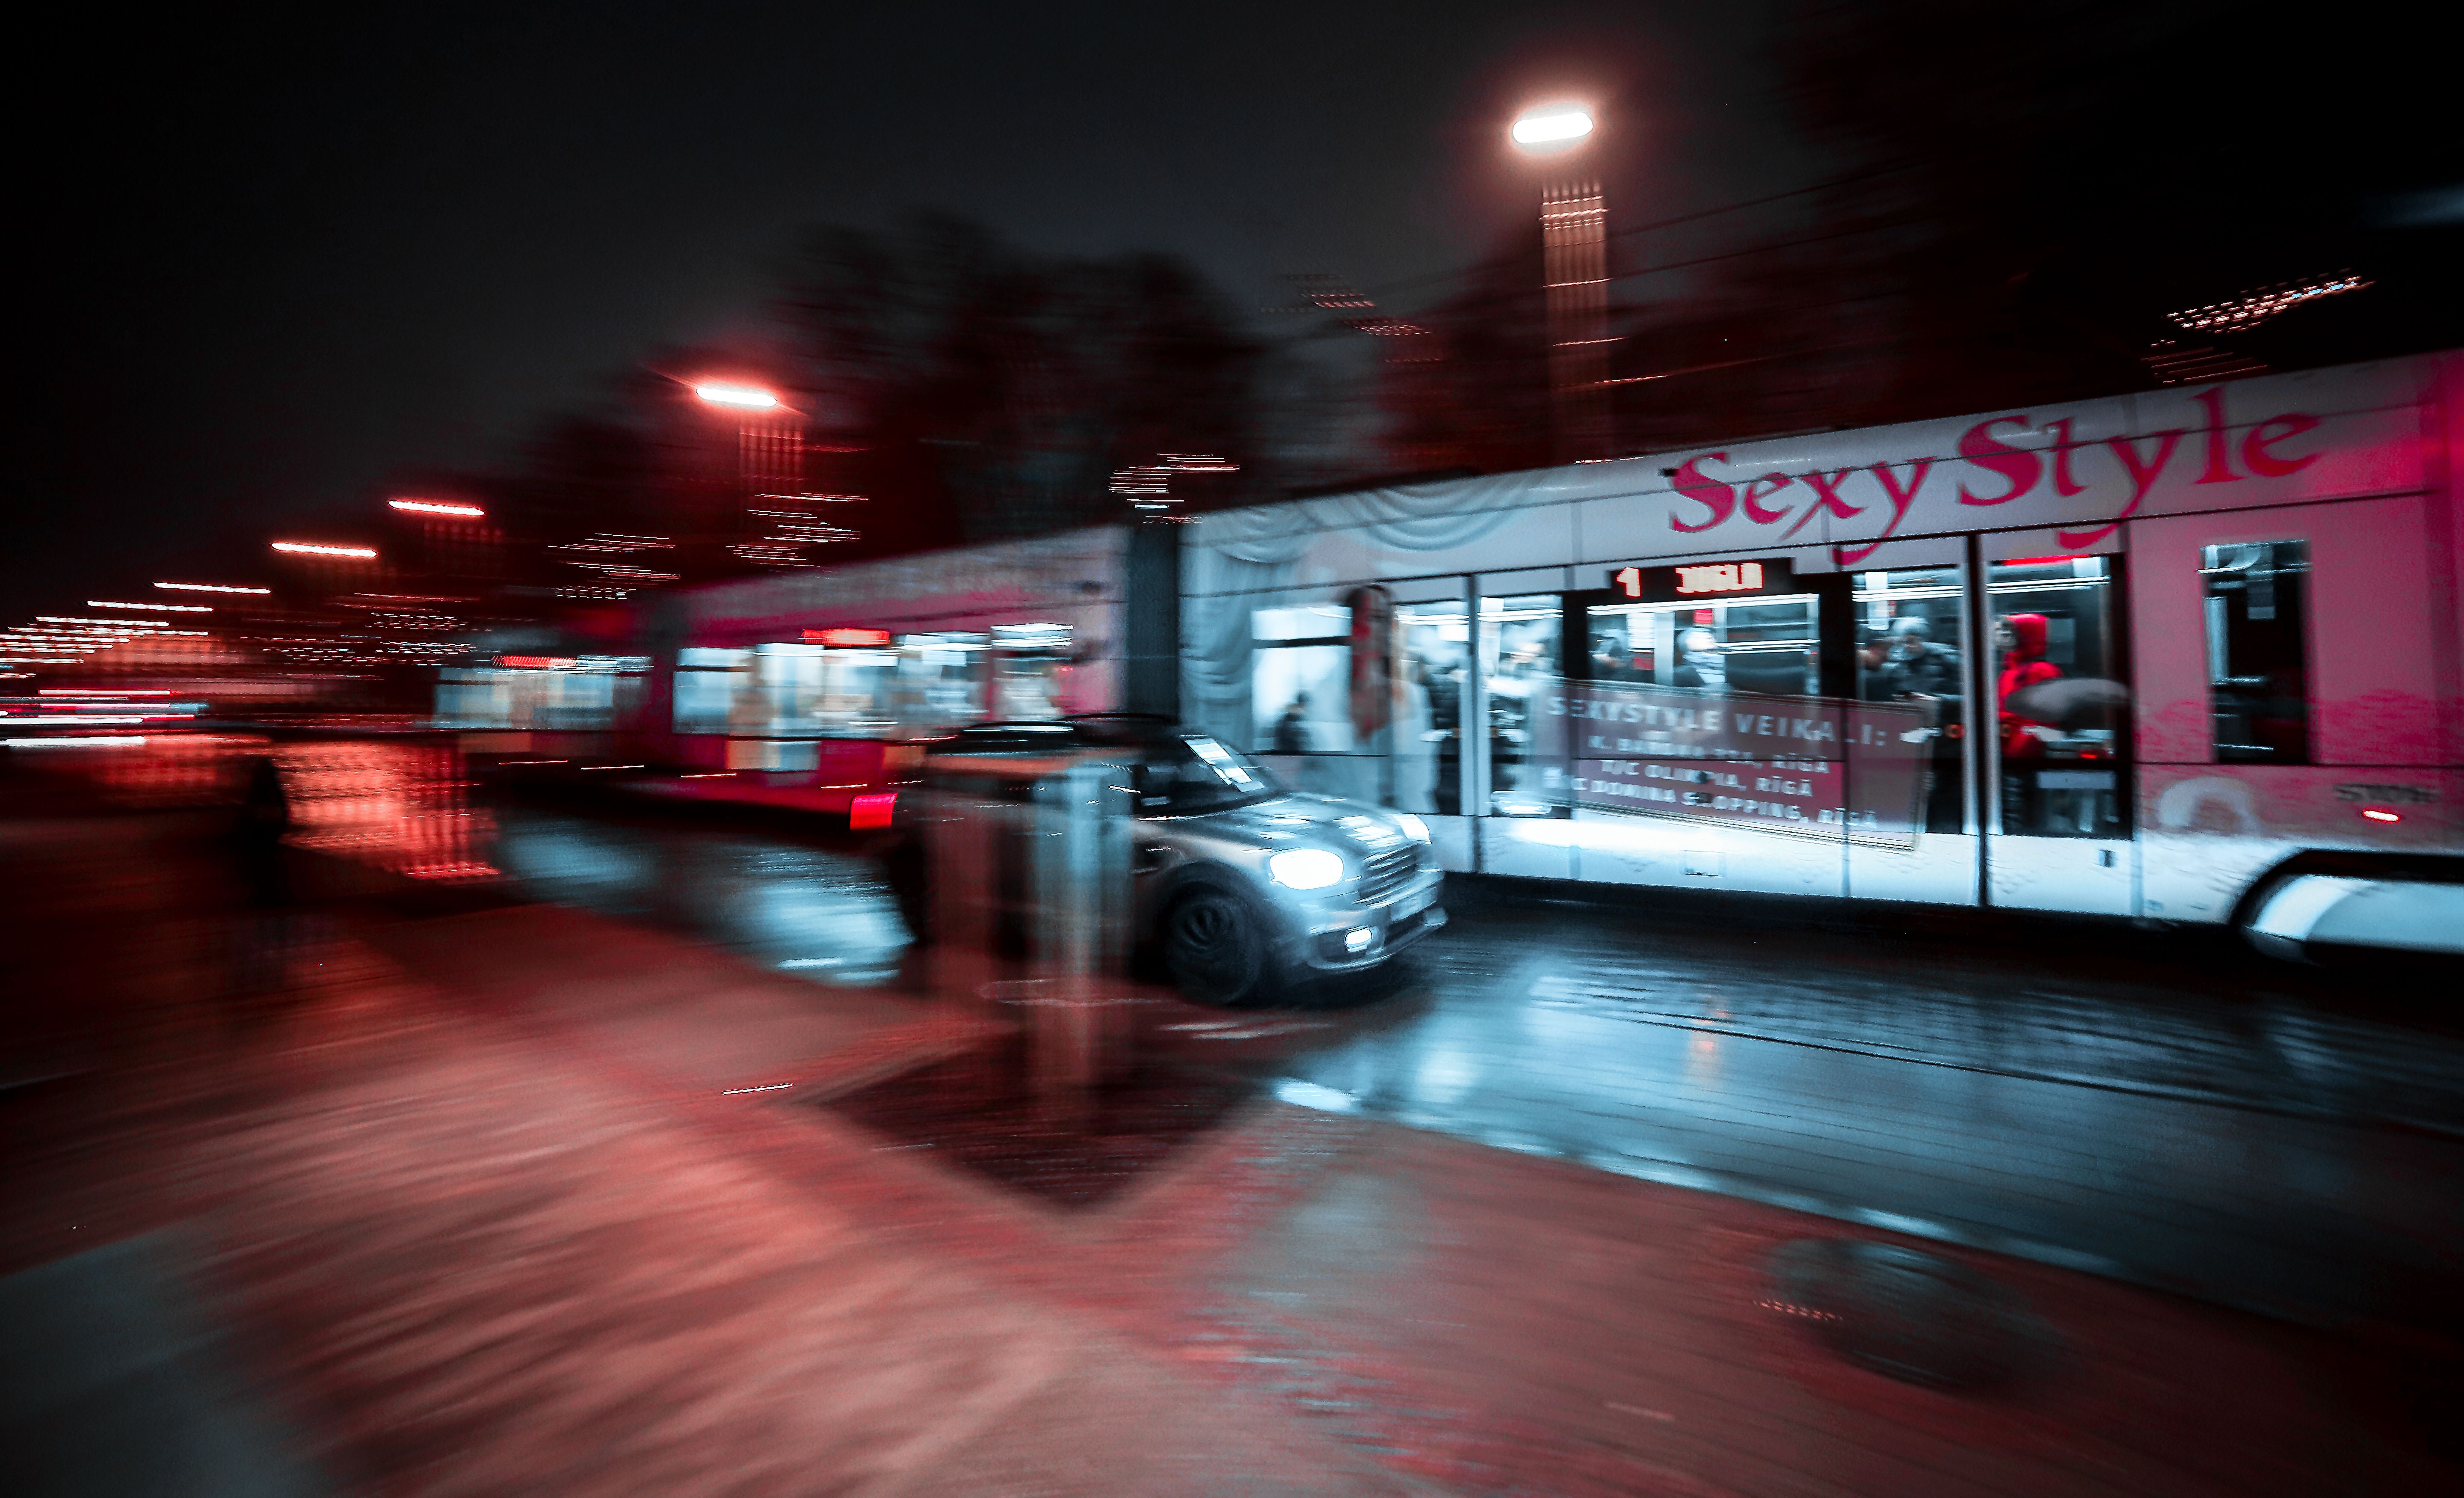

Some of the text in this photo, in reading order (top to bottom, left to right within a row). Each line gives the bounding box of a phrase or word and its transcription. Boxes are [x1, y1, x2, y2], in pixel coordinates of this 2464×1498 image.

[1667, 386, 2323, 567] Sexy Style
[1616, 567, 1641, 598] 1
[1680, 791, 1809, 823] SOPPING,
